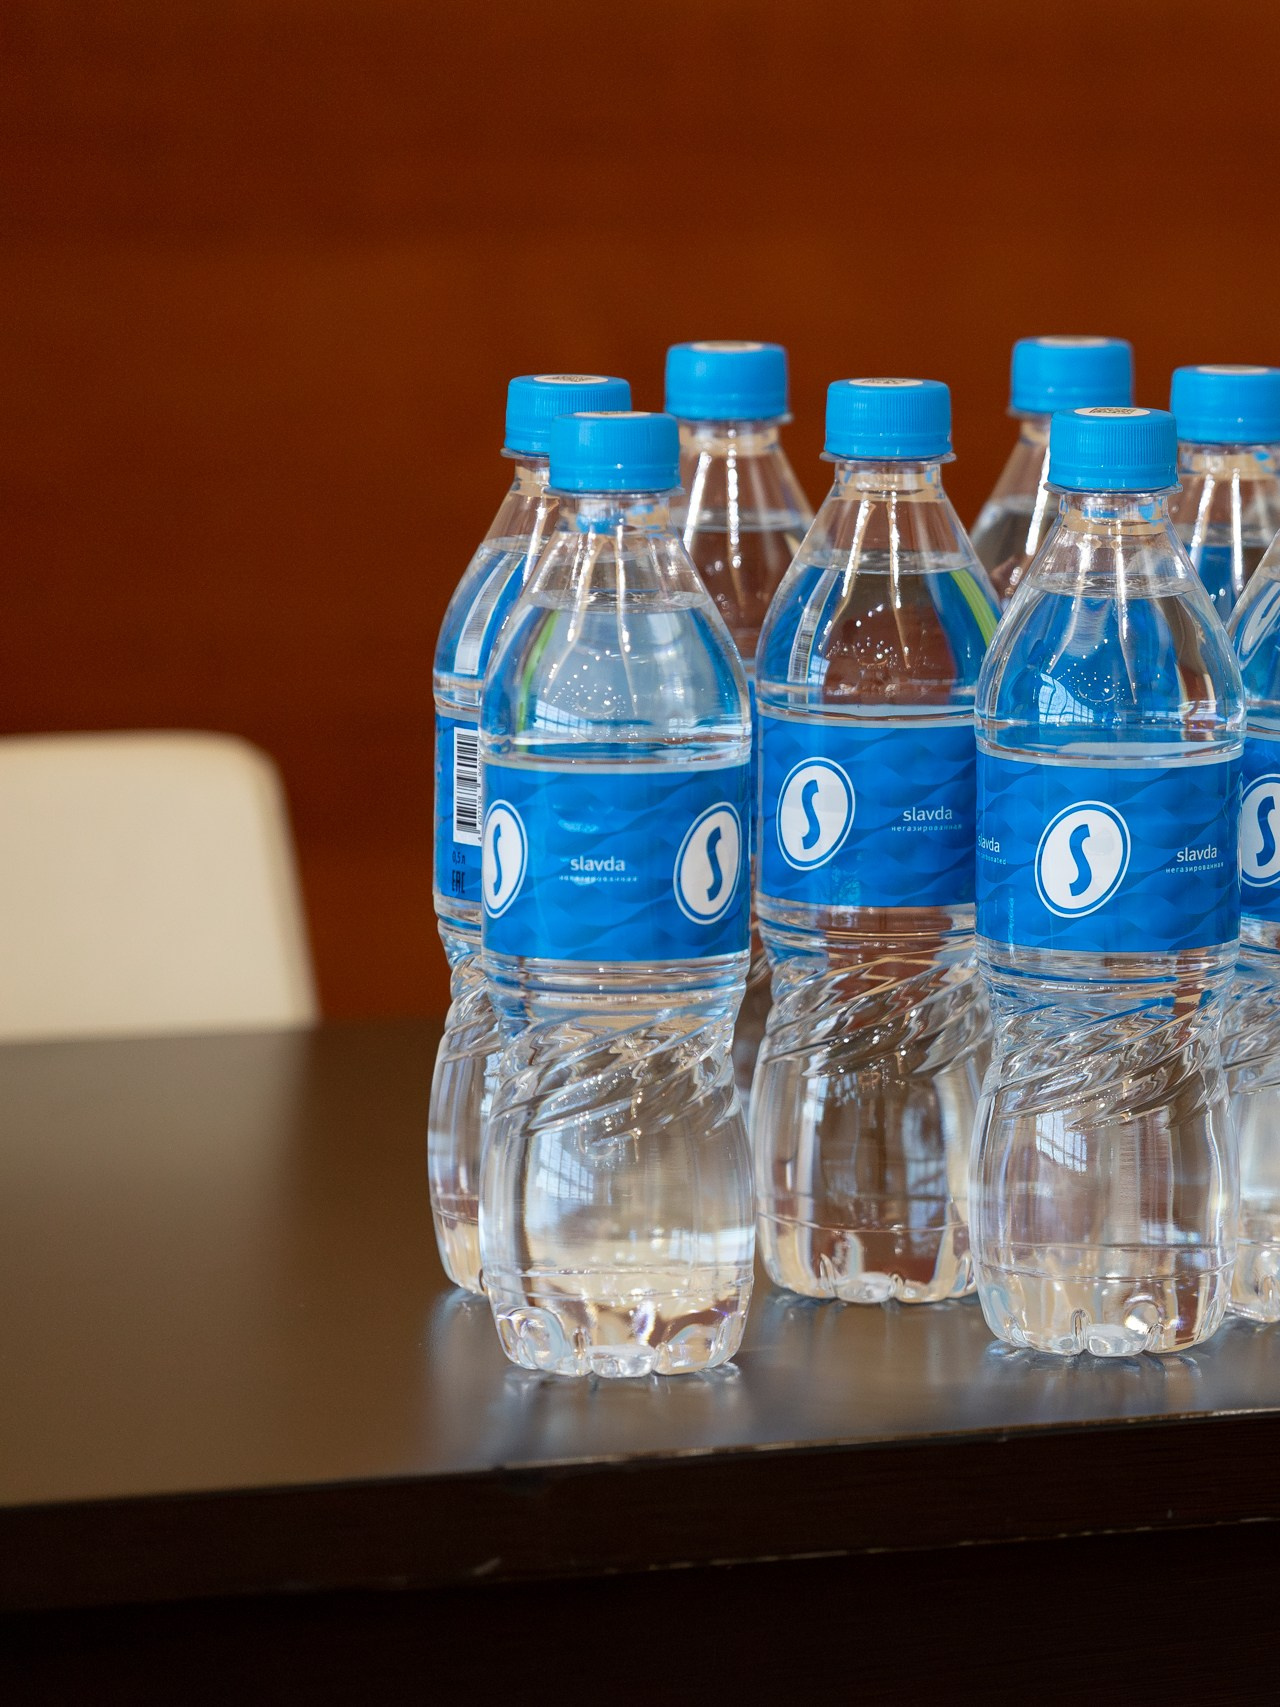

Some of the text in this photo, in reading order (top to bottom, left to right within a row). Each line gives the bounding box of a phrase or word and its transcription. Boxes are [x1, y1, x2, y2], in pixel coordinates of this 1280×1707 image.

[903, 805, 953, 821] slavda
[978, 833, 1000, 853] slavda
[1176, 844, 1217, 862] slavda
[570, 855, 626, 871] slavda
[1165, 861, 1224, 874] негазированная
